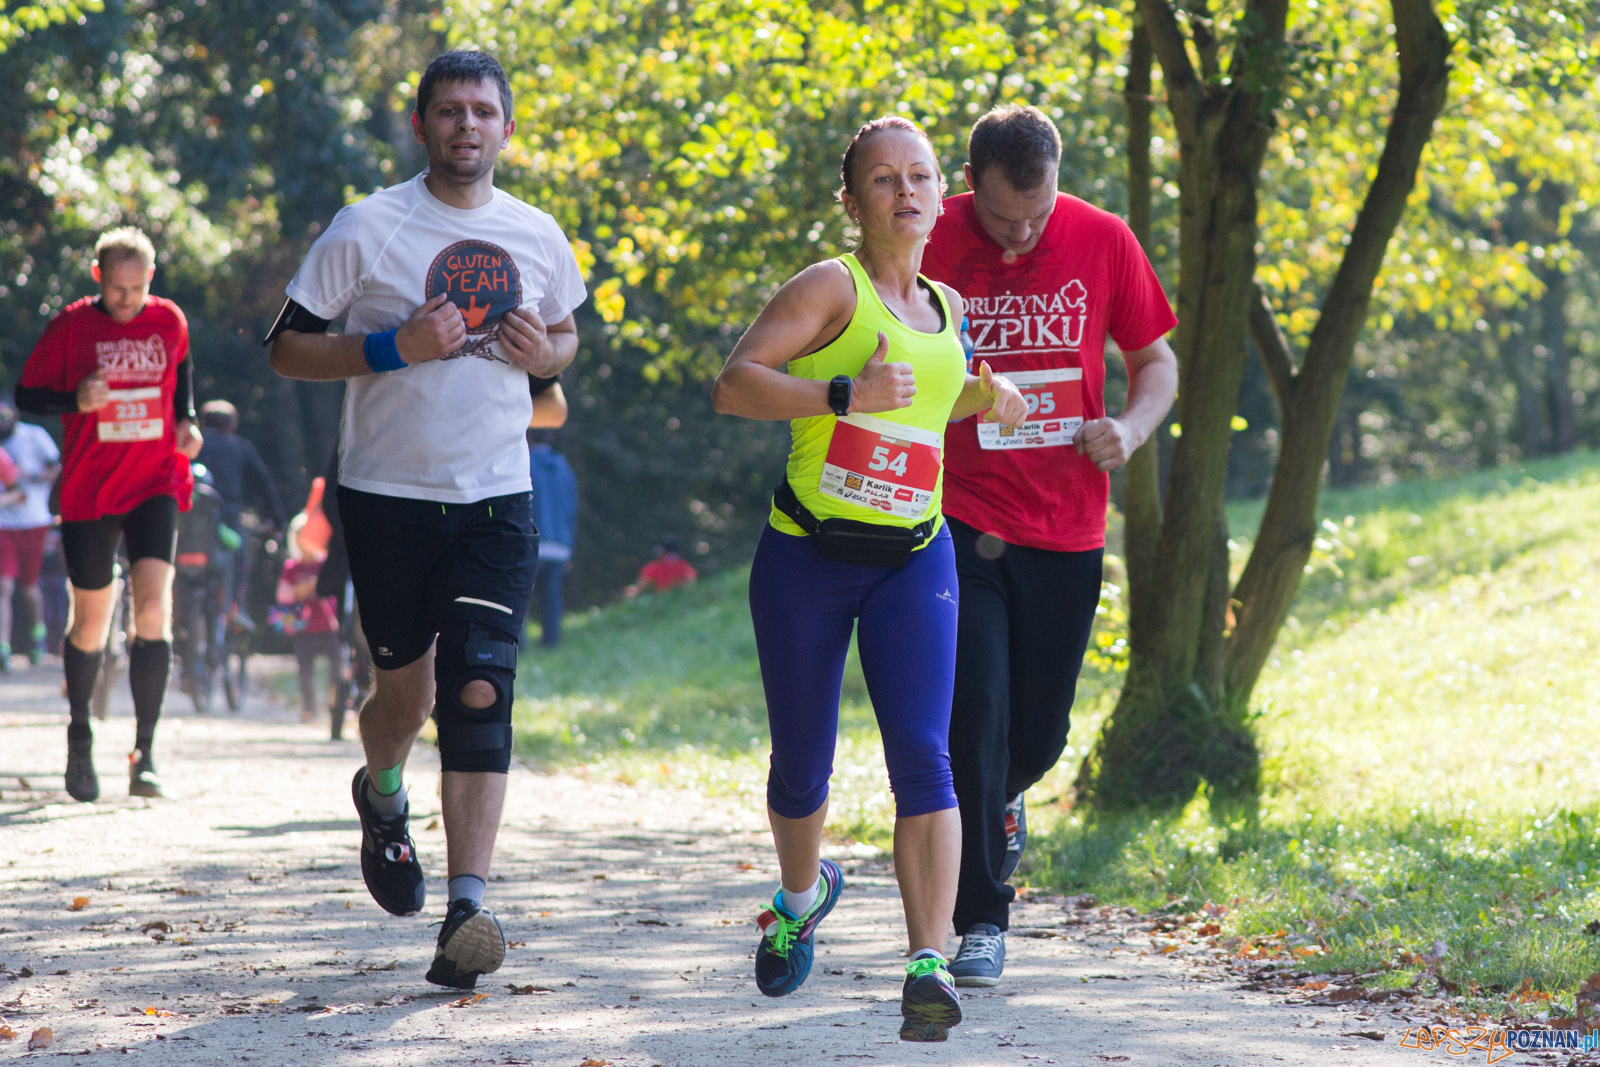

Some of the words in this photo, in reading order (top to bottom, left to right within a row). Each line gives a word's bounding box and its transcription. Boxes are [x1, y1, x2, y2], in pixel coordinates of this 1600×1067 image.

[446, 254, 502, 270] GLUTEN
[442, 270, 508, 293] YEAH
[971, 314, 1087, 351] ZPIKU
[1018, 423, 1041, 431] arlik
[868, 445, 908, 477] 54
[864, 489, 889, 499] POLAR
[866, 480, 893, 493] Karlik
